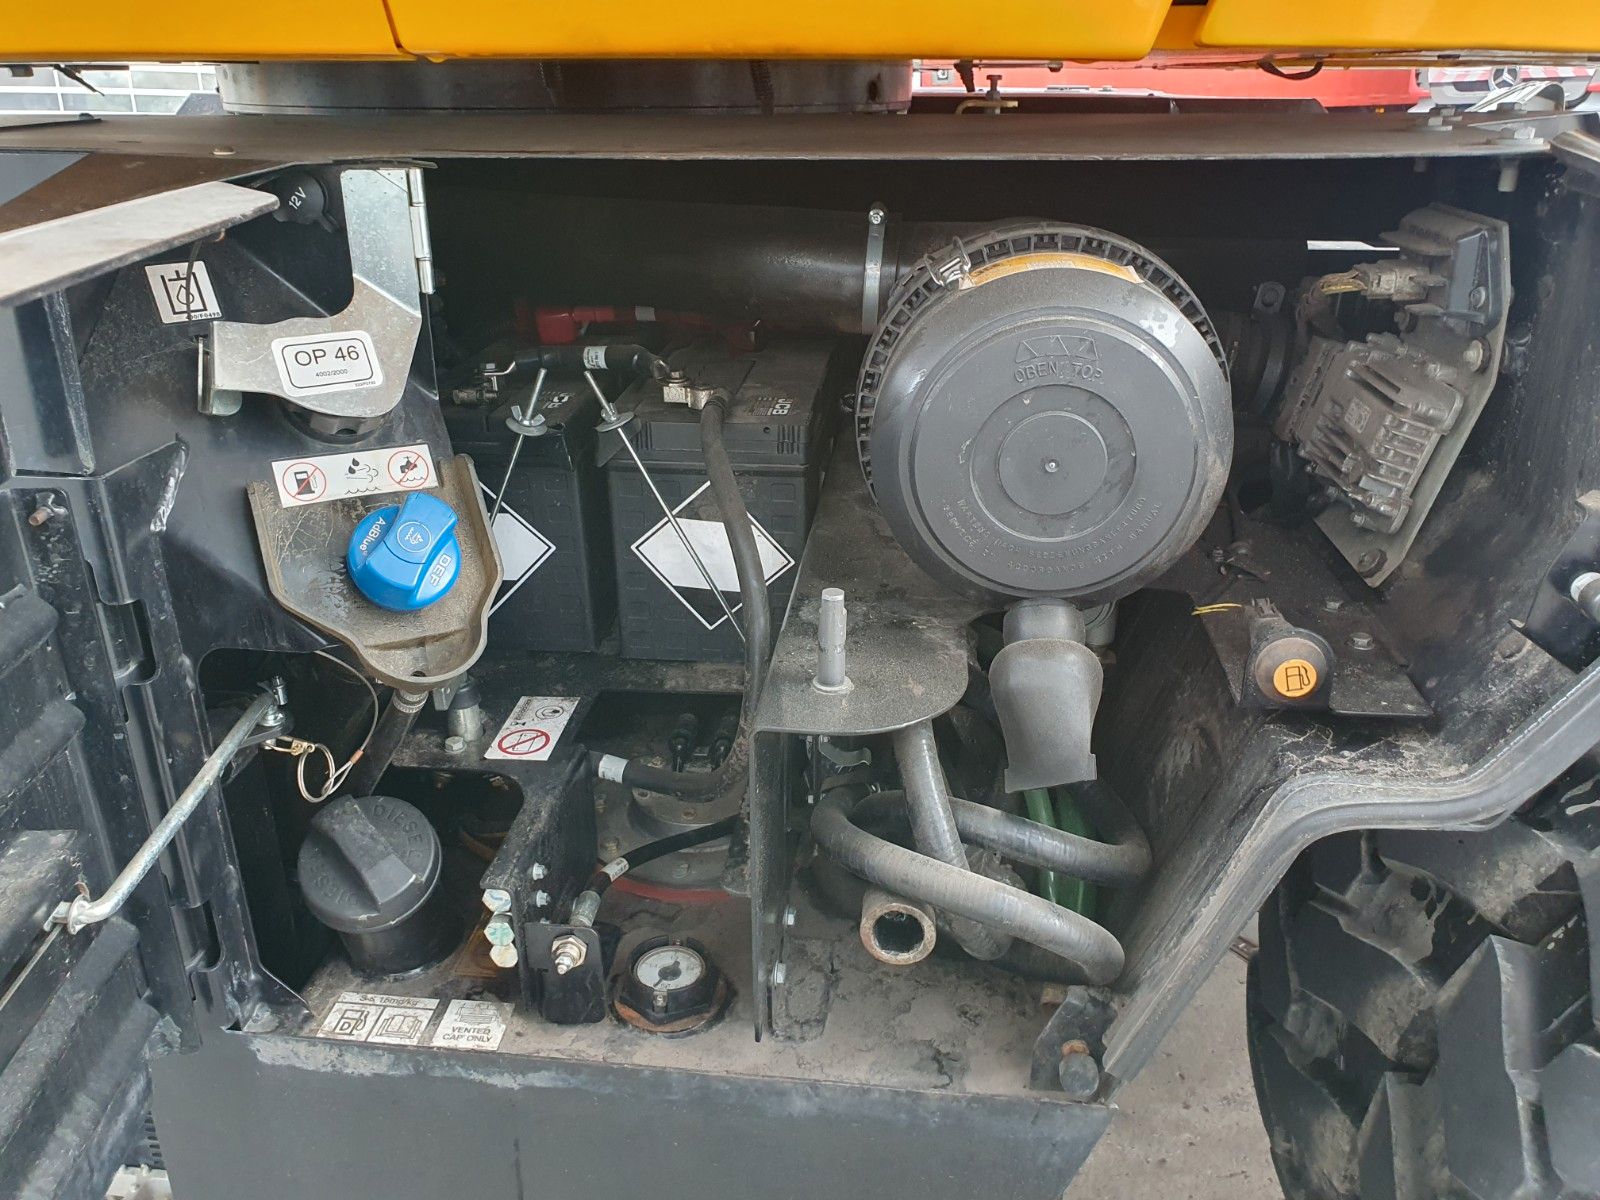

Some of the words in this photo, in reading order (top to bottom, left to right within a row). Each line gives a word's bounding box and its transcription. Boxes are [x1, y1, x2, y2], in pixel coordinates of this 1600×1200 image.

[288, 186, 306, 210] 12V
[294, 348, 327, 366] OP
[334, 345, 360, 362] 46
[315, 368, 348, 378] 4002/2000
[1014, 361, 1058, 382] OBEN
[1071, 361, 1104, 381] TOP
[771, 398, 794, 415] JCB
[429, 553, 452, 587] DEF
[373, 804, 423, 857] DIESEL
[442, 1033, 465, 1042] CAP
[466, 1034, 493, 1044] ONLY
[451, 1025, 492, 1035] VENTED
